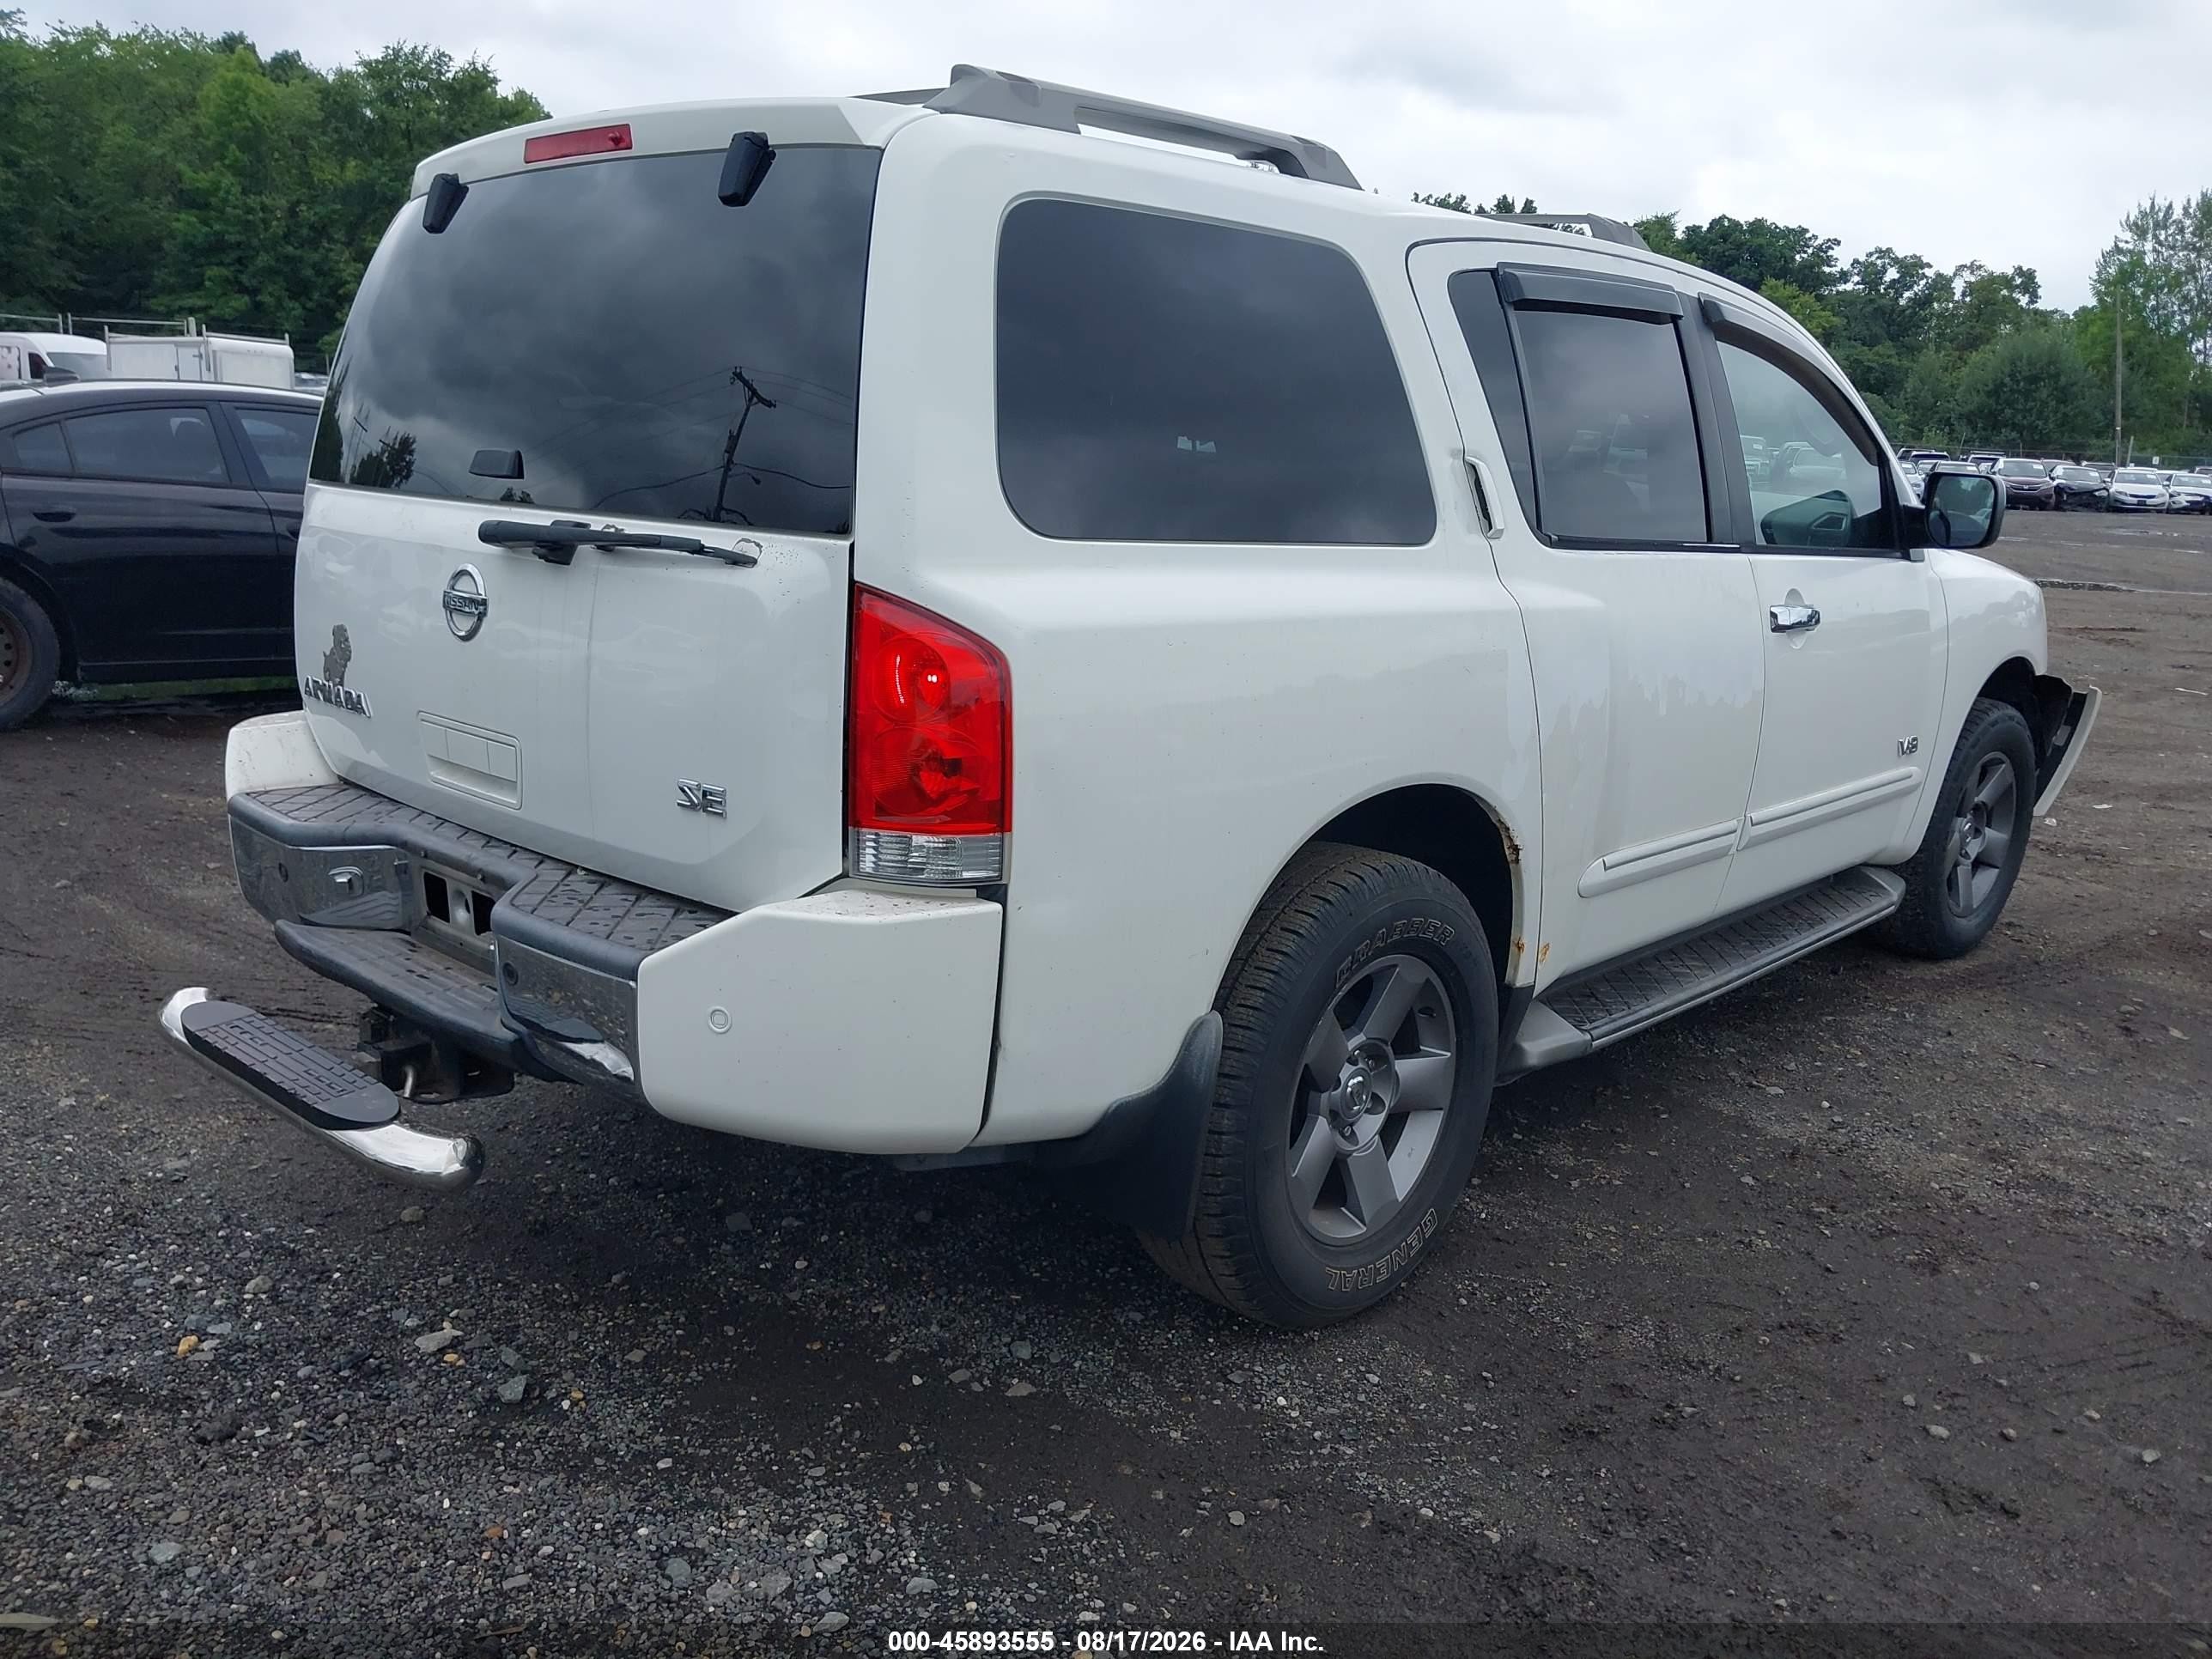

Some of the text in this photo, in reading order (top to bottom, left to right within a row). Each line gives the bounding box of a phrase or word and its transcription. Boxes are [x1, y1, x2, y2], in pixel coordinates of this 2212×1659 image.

[1897, 736, 1917, 757] V8
[676, 778, 727, 818] SE
[1325, 1208, 1437, 1291] GENERAL
